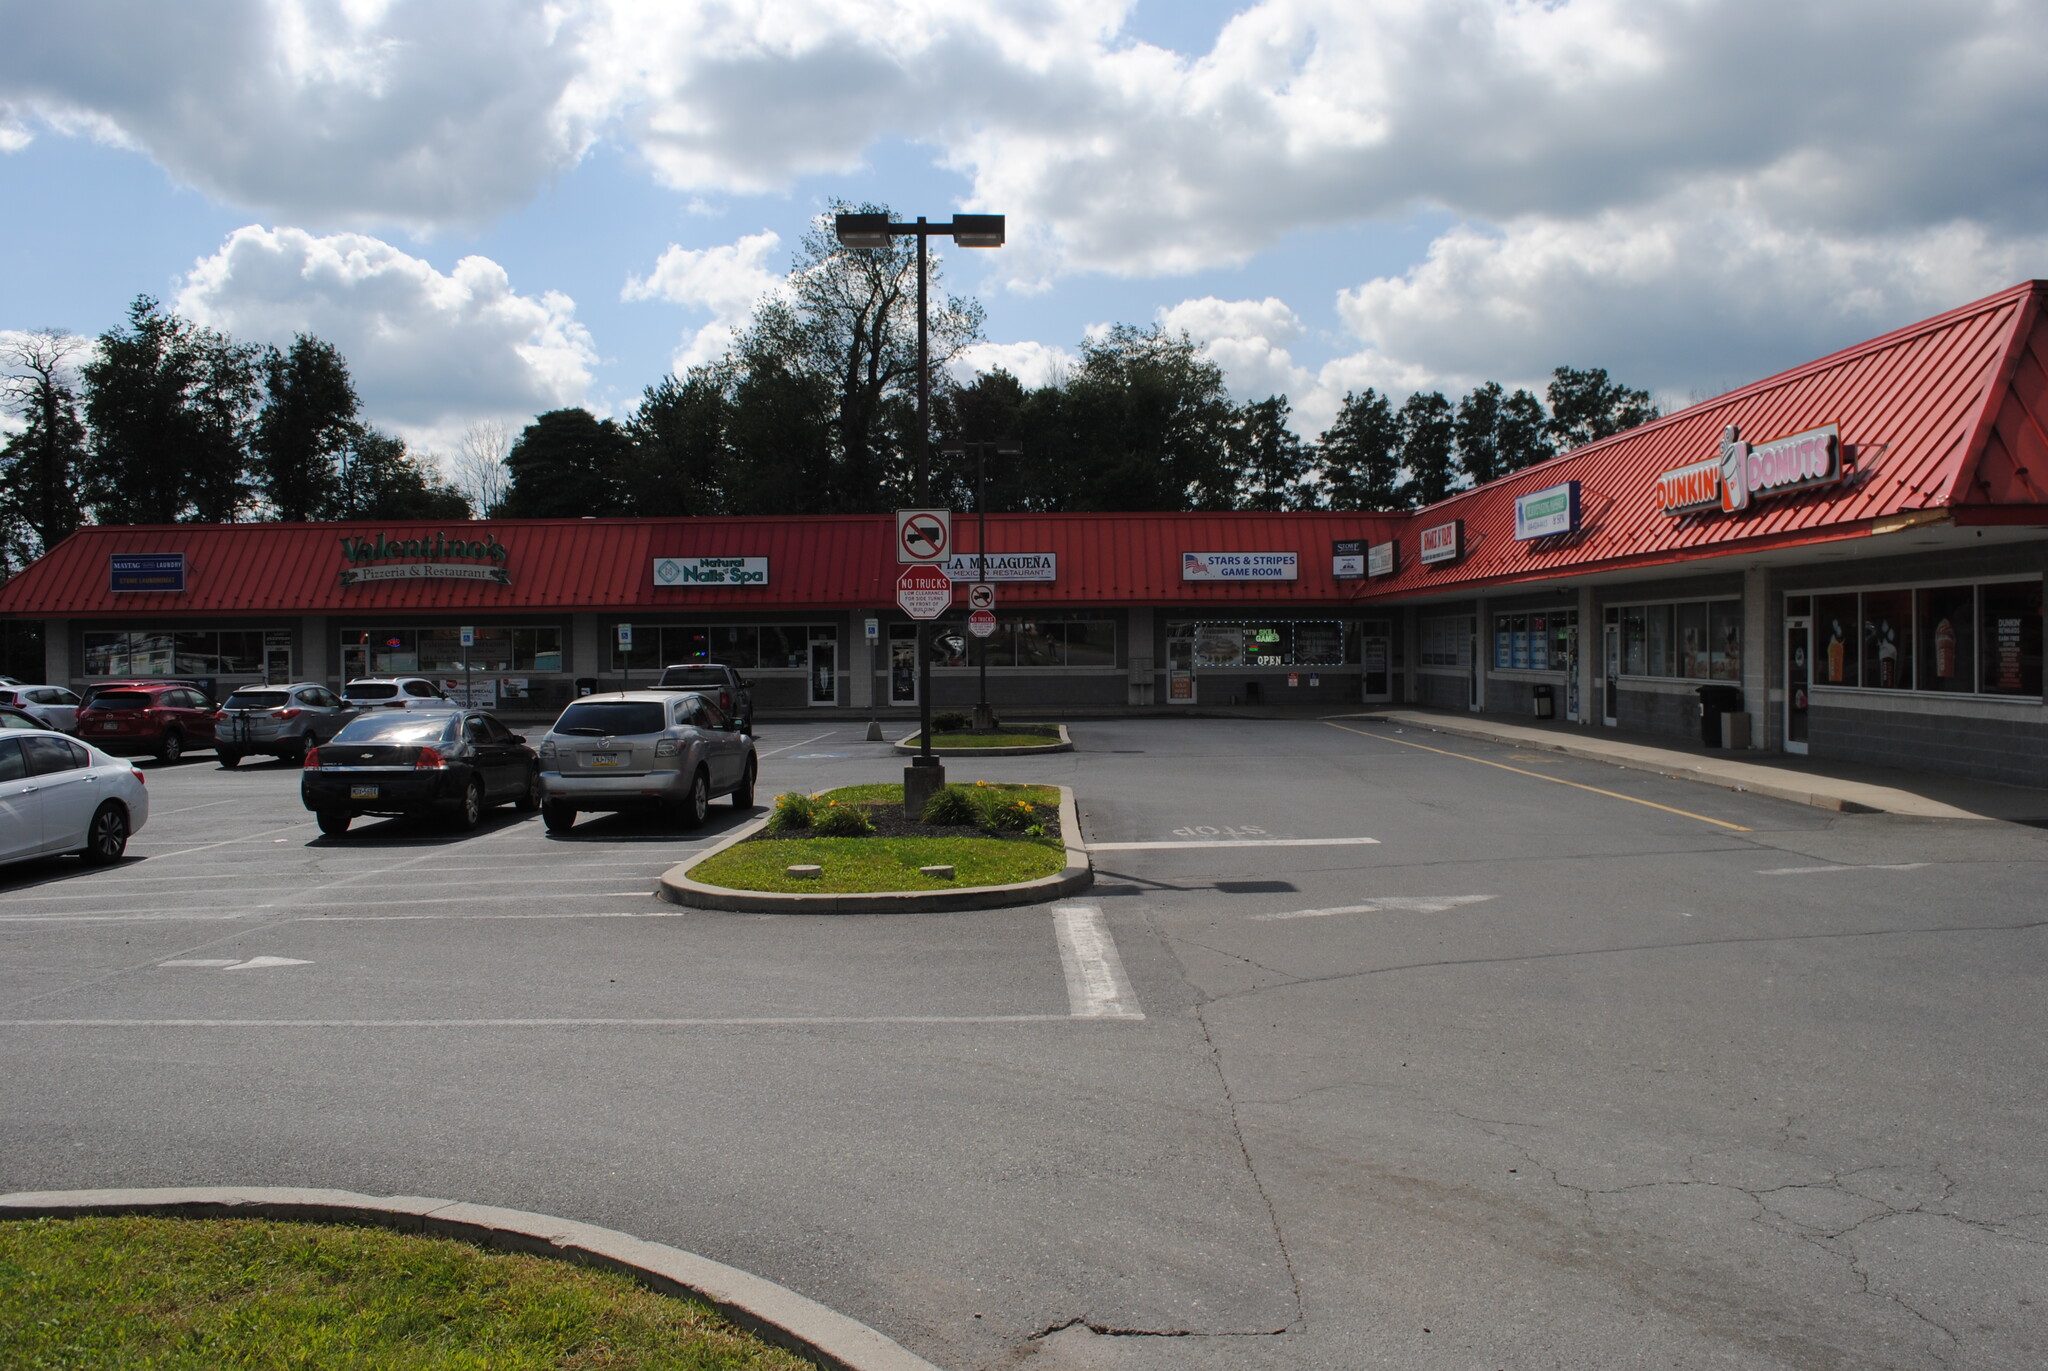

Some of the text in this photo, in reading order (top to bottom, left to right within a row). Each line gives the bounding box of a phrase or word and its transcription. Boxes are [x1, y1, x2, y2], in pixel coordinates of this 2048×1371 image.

[1747, 434, 1831, 492] DONUTS
[1656, 464, 1721, 511] DUNKIN'
[340, 531, 507, 563] Valentino's
[700, 558, 745, 568] Natural
[947, 558, 964, 569] LA
[1208, 556, 1295, 565] STARS & STRIPES
[362, 564, 487, 580] Pizzeria & Restaurant
[683, 565, 725, 582] Nails
[730, 567, 764, 584] Spa
[902, 578, 947, 589] NO TRUCKS
[1998, 618, 2021, 627] DUNKIN'
[1255, 634, 1280, 642] GAMES
[1257, 656, 1282, 666] OPEN
[1172, 824, 1267, 838] STOP
